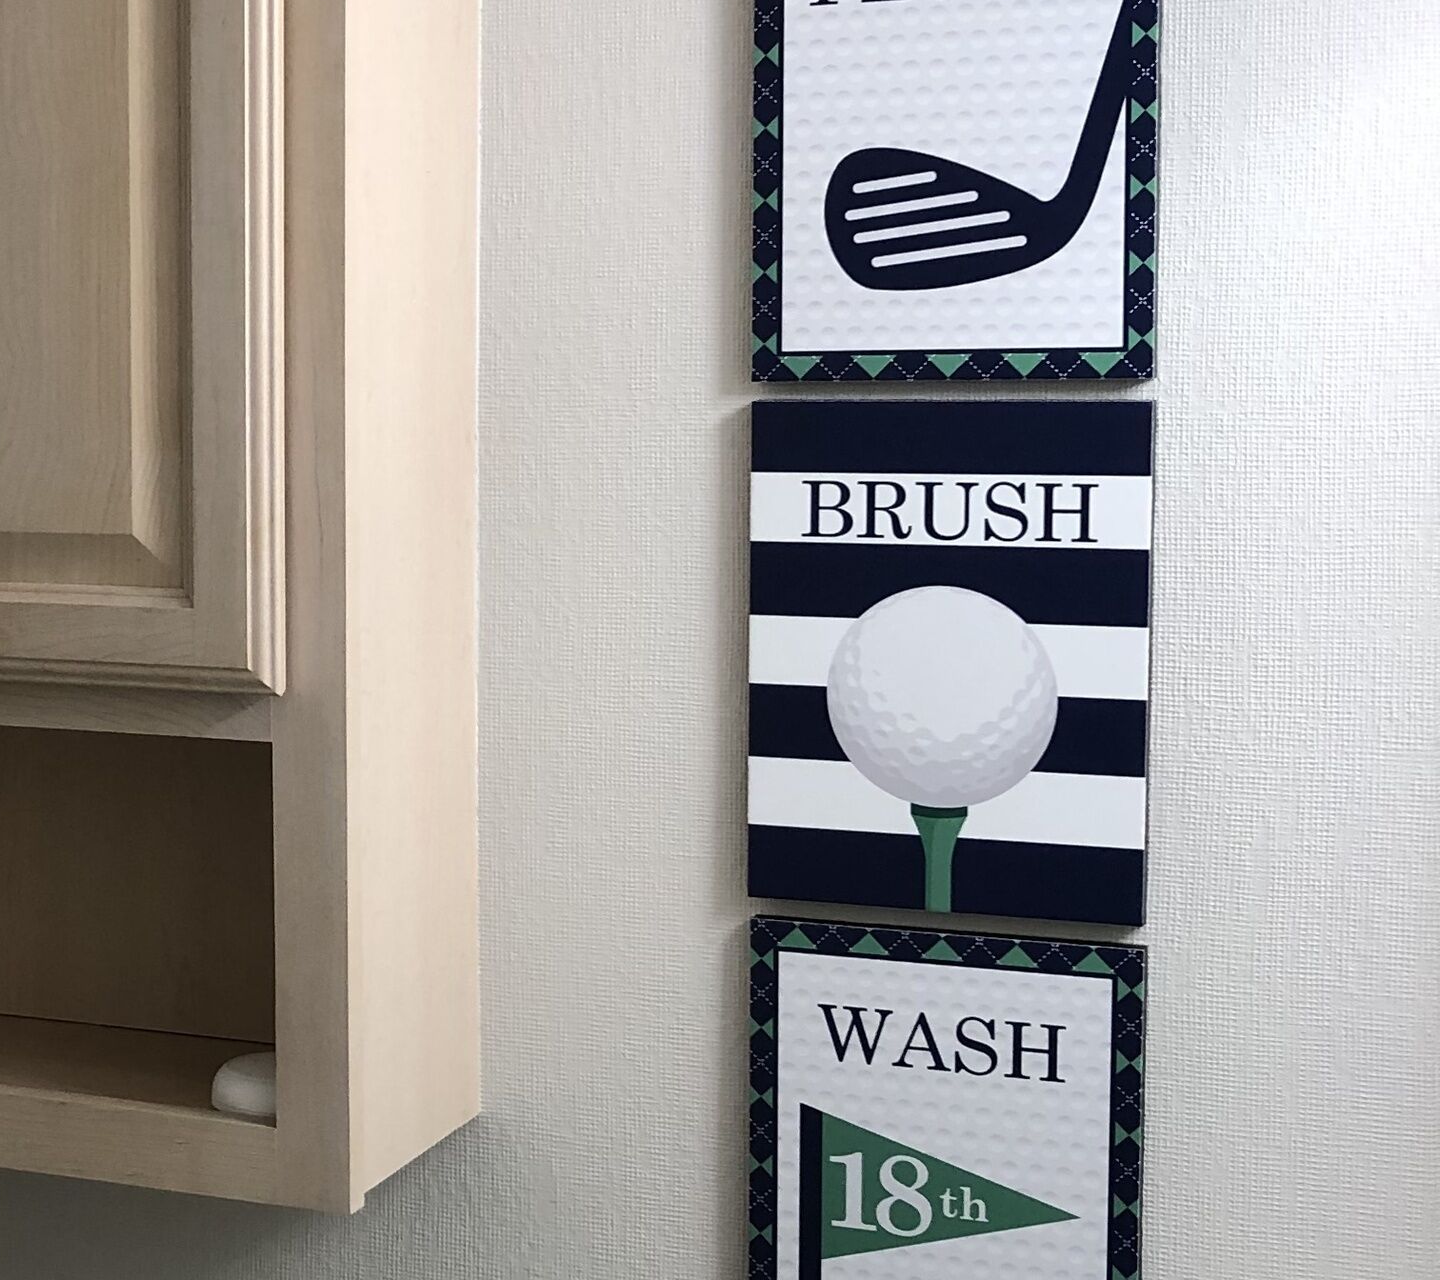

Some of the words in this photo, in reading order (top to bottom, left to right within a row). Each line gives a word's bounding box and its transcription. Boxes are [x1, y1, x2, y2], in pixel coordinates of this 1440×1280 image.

[801, 480, 1099, 542] BRUSH
[817, 1003, 1066, 1083] WASH
[829, 1151, 988, 1237] 18th
